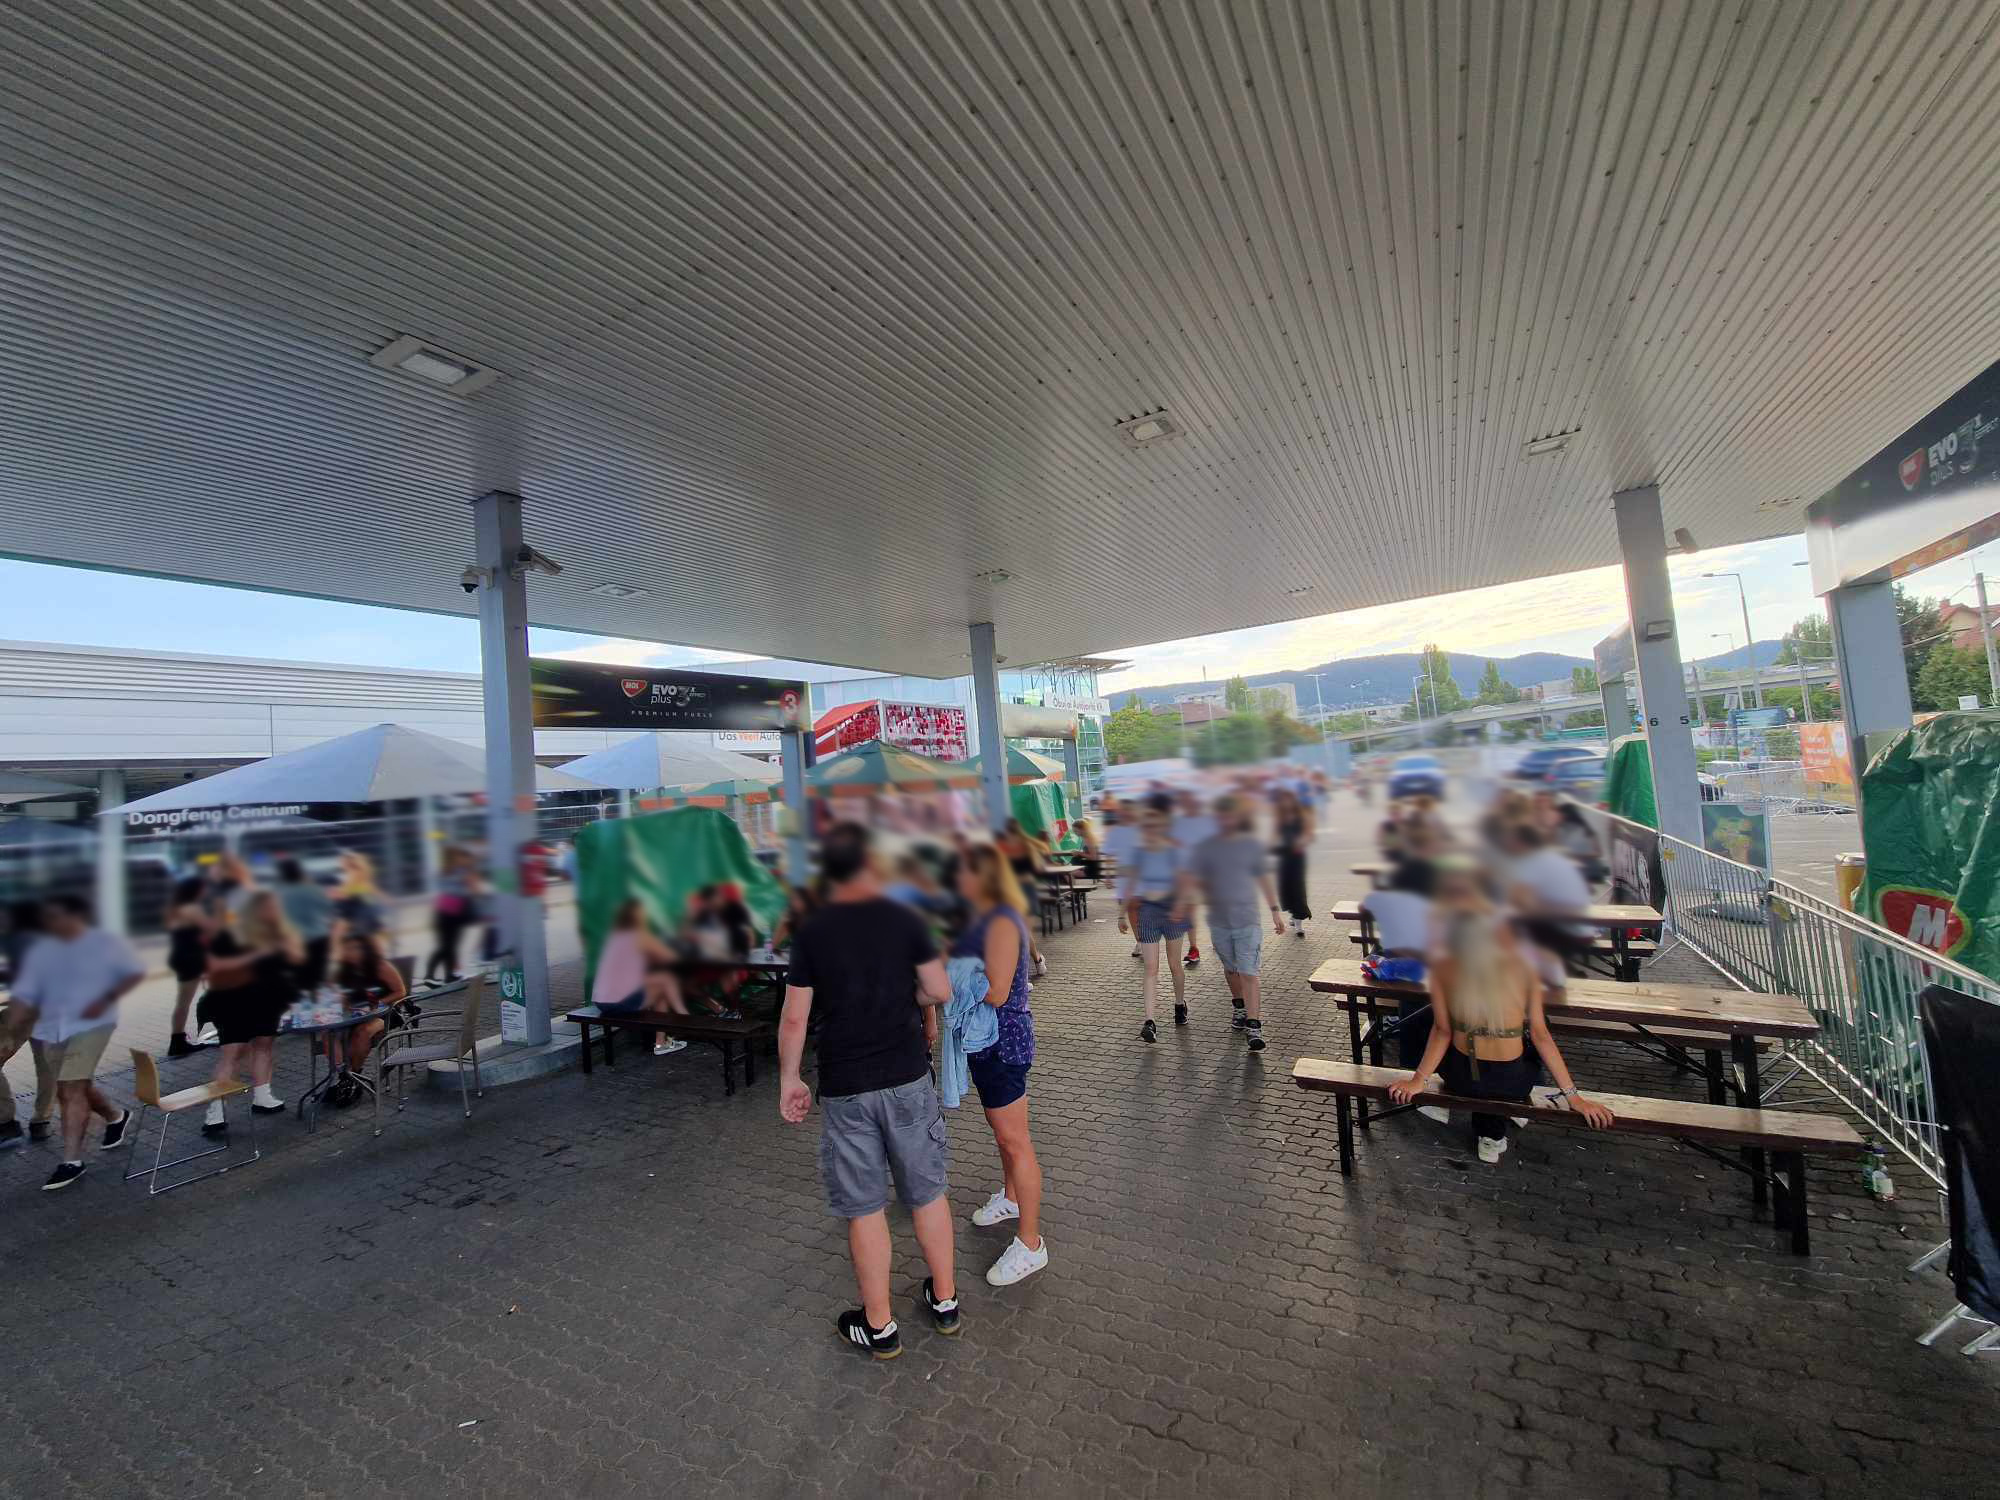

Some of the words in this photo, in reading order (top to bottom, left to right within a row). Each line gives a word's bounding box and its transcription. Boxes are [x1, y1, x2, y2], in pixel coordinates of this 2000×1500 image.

[1928, 432, 1958, 468] EVO
[1929, 461, 1954, 486] plus
[652, 684, 677, 695] EVO
[651, 695, 672, 705] plus
[785, 694, 798, 713] 3
[1650, 717, 1658, 726] 6
[1680, 716, 1689, 724] 5
[129, 809, 222, 825] Dongfeng
[228, 805, 301, 818] Centrum
